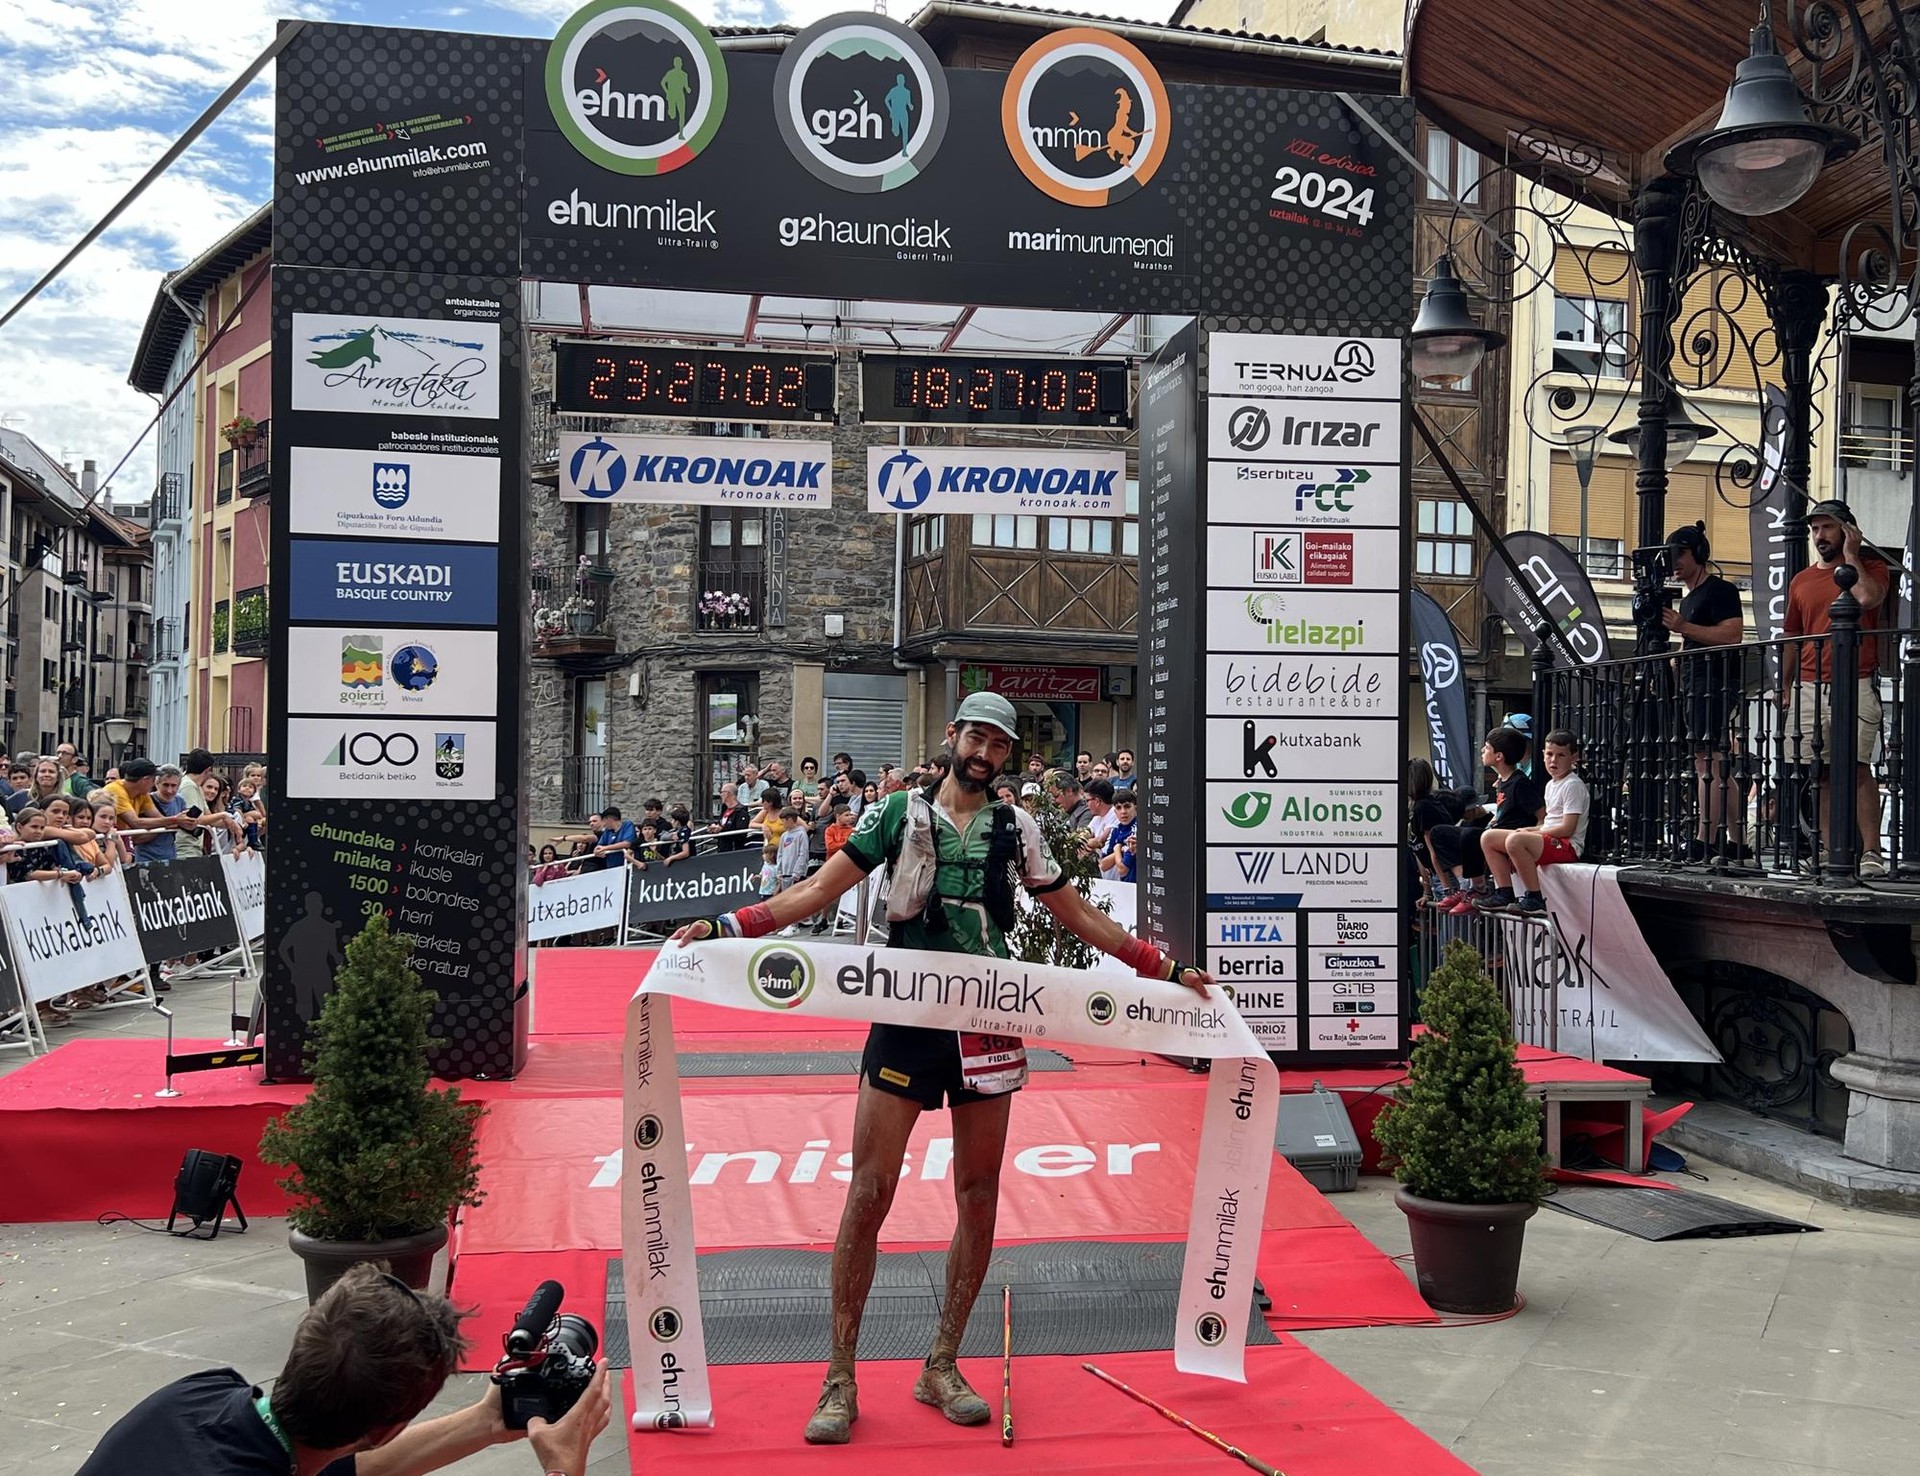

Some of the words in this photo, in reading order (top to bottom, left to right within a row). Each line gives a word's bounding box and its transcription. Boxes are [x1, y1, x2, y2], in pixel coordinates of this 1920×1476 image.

[576, 78, 665, 121] ehm
[812, 101, 883, 144] g2h
[296, 140, 487, 186] www.ehunmilak.com
[412, 159, 490, 178] info@ehunmilak.com
[1271, 166, 1374, 226] 2024
[547, 188, 716, 234] ehunmilak
[1269, 209, 1310, 224] uztailak
[779, 213, 951, 249] g2haundiak
[1008, 228, 1174, 258] marimurumendi
[896, 251, 929, 262] Goierri
[932, 253, 953, 262] Trail
[1134, 261, 1173, 271] Marathon
[445, 297, 500, 308] antolatzailea
[454, 308, 500, 318] organizador
[1234, 362, 1338, 382] TERNUA
[324, 358, 487, 408] Arrastaka
[588, 358, 804, 409] 23:27:02
[907, 367, 1098, 412] 18:27:03
[391, 431, 428, 442] babesle
[431, 433, 499, 444] instituzionalak
[1282, 416, 1380, 447] Irizar
[378, 442, 440, 452] patrocinadores
[441, 444, 499, 454] institucionales
[633, 454, 826, 490] KRONOAK
[937, 465, 1121, 496] KRONOAK
[720, 487, 818, 503] kronoak.com
[1019, 496, 1111, 510] kronoak.com
[1296, 484, 1355, 511] FCC
[337, 512, 384, 522] Gipuzkoako
[386, 513, 405, 522] Foru
[407, 515, 443, 524] Aldundia
[378, 522, 397, 530] Foral
[399, 523, 408, 531] de
[1305, 542, 1352, 551] Goi-mailako
[1309, 552, 1348, 561] elikagaiak
[336, 562, 451, 586] EUSKADI
[1257, 572, 1278, 580] EUSKO
[1279, 572, 1298, 580] LABEL
[336, 588, 387, 601] BASQUE
[391, 590, 453, 602] COUNTRY
[1267, 619, 1364, 651] itelazpi
[1002, 666, 1056, 674] DIETETIKA
[1226, 662, 1381, 693] bidebide
[340, 690, 384, 703] goierri
[1280, 733, 1362, 747] kutxabank
[339, 772, 385, 781] Betidanik
[387, 772, 417, 781] betiko
[1281, 796, 1382, 823] Alonso
[310, 823, 395, 851] ehundaka
[414, 839, 485, 867] korrikalari
[334, 850, 392, 872] milaka
[409, 861, 453, 883] ikusle
[1282, 852, 1368, 874] LANDU
[349, 873, 388, 895] 1500
[405, 883, 479, 912] bolondres
[639, 867, 755, 905] kutxabank
[135, 881, 228, 932] kutxabank
[360, 900, 383, 916] 30
[400, 906, 434, 926] herri
[528, 887, 614, 925] utxabank
[1337, 914, 1347, 922] EL
[1337, 922, 1368, 931] DIARIO
[19, 900, 127, 963] kutxabank
[1221, 924, 1282, 942] HITZA
[1337, 932, 1368, 940] VASCO
[428, 957, 470, 978] natural
[1219, 955, 1284, 975] berria
[1328, 957, 1375, 969] Gipuzkoa
[759, 973, 792, 990] ehm
[837, 951, 1046, 1017] ehunmilak
[1127, 997, 1226, 1028] ehunmilak
[1560, 1009, 1619, 1028] TRAIL
[988, 1054, 1011, 1063] FIDEL
[641, 1161, 671, 1280] ehunmilak
[1204, 1187, 1240, 1300] ehunmilak
